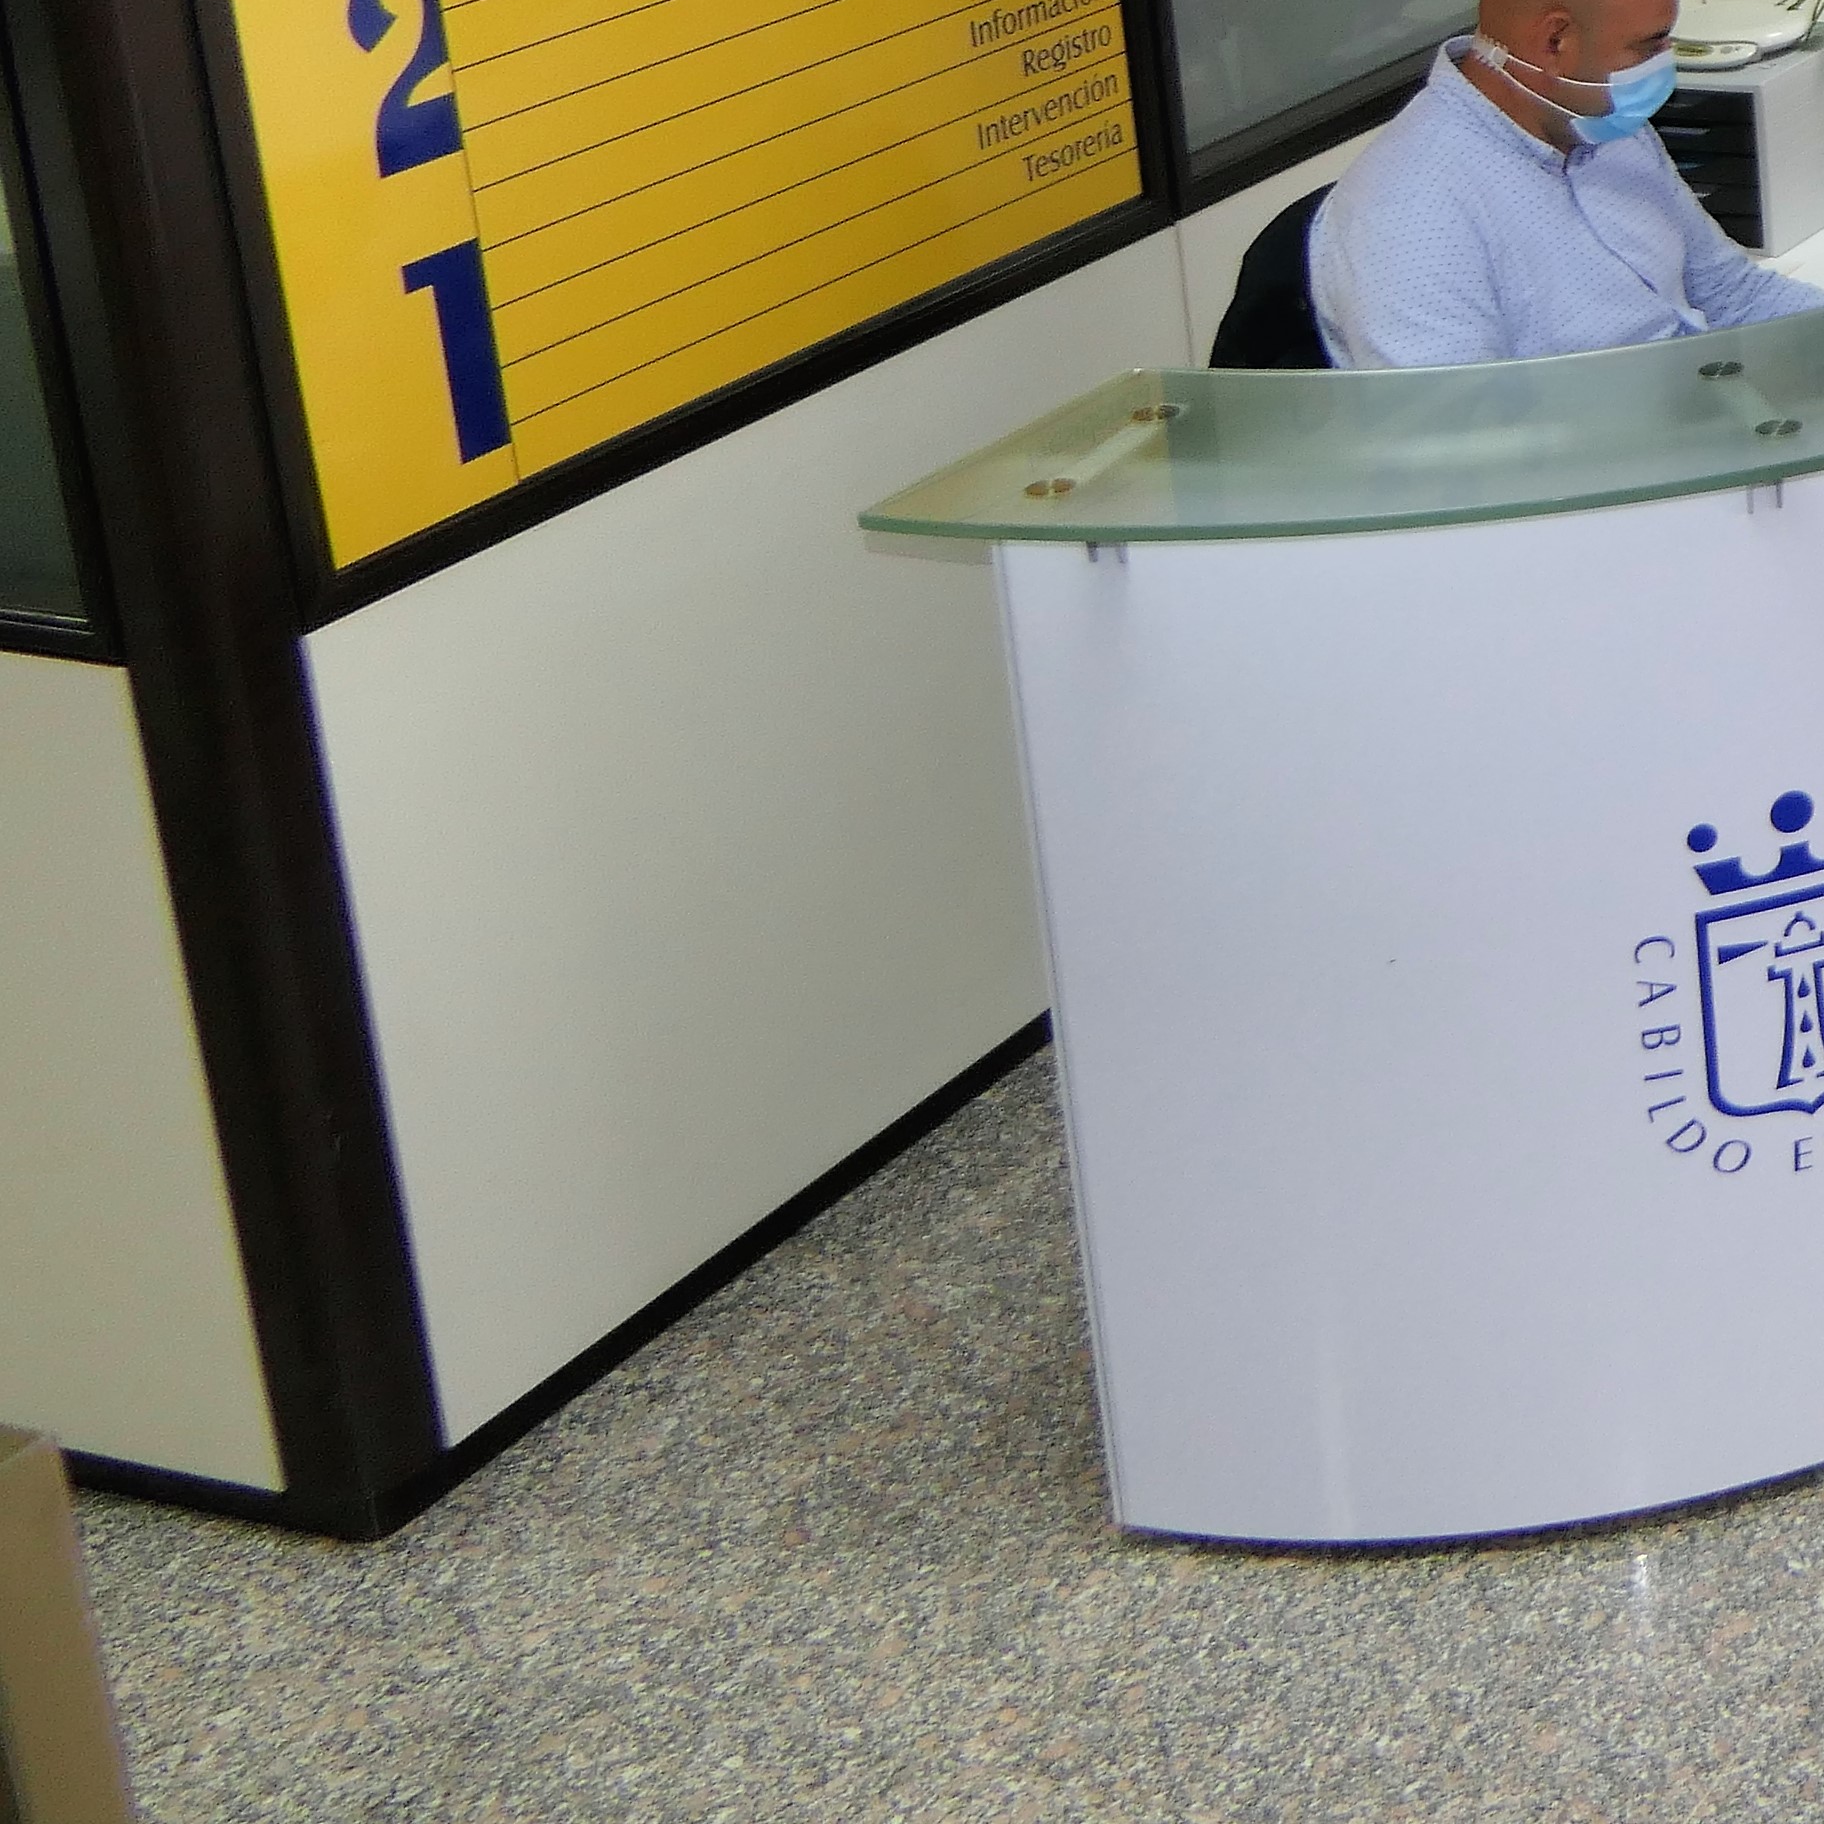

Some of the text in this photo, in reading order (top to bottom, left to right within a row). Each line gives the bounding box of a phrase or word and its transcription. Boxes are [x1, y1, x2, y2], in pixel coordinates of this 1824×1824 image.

[1022, 25, 1112, 77] Registro
[976, 72, 1119, 150] Intervención
[1021, 120, 1124, 182] Tesorería
[403, 236, 513, 465] 1
[1634, 935, 1752, 1173] CABILDO
